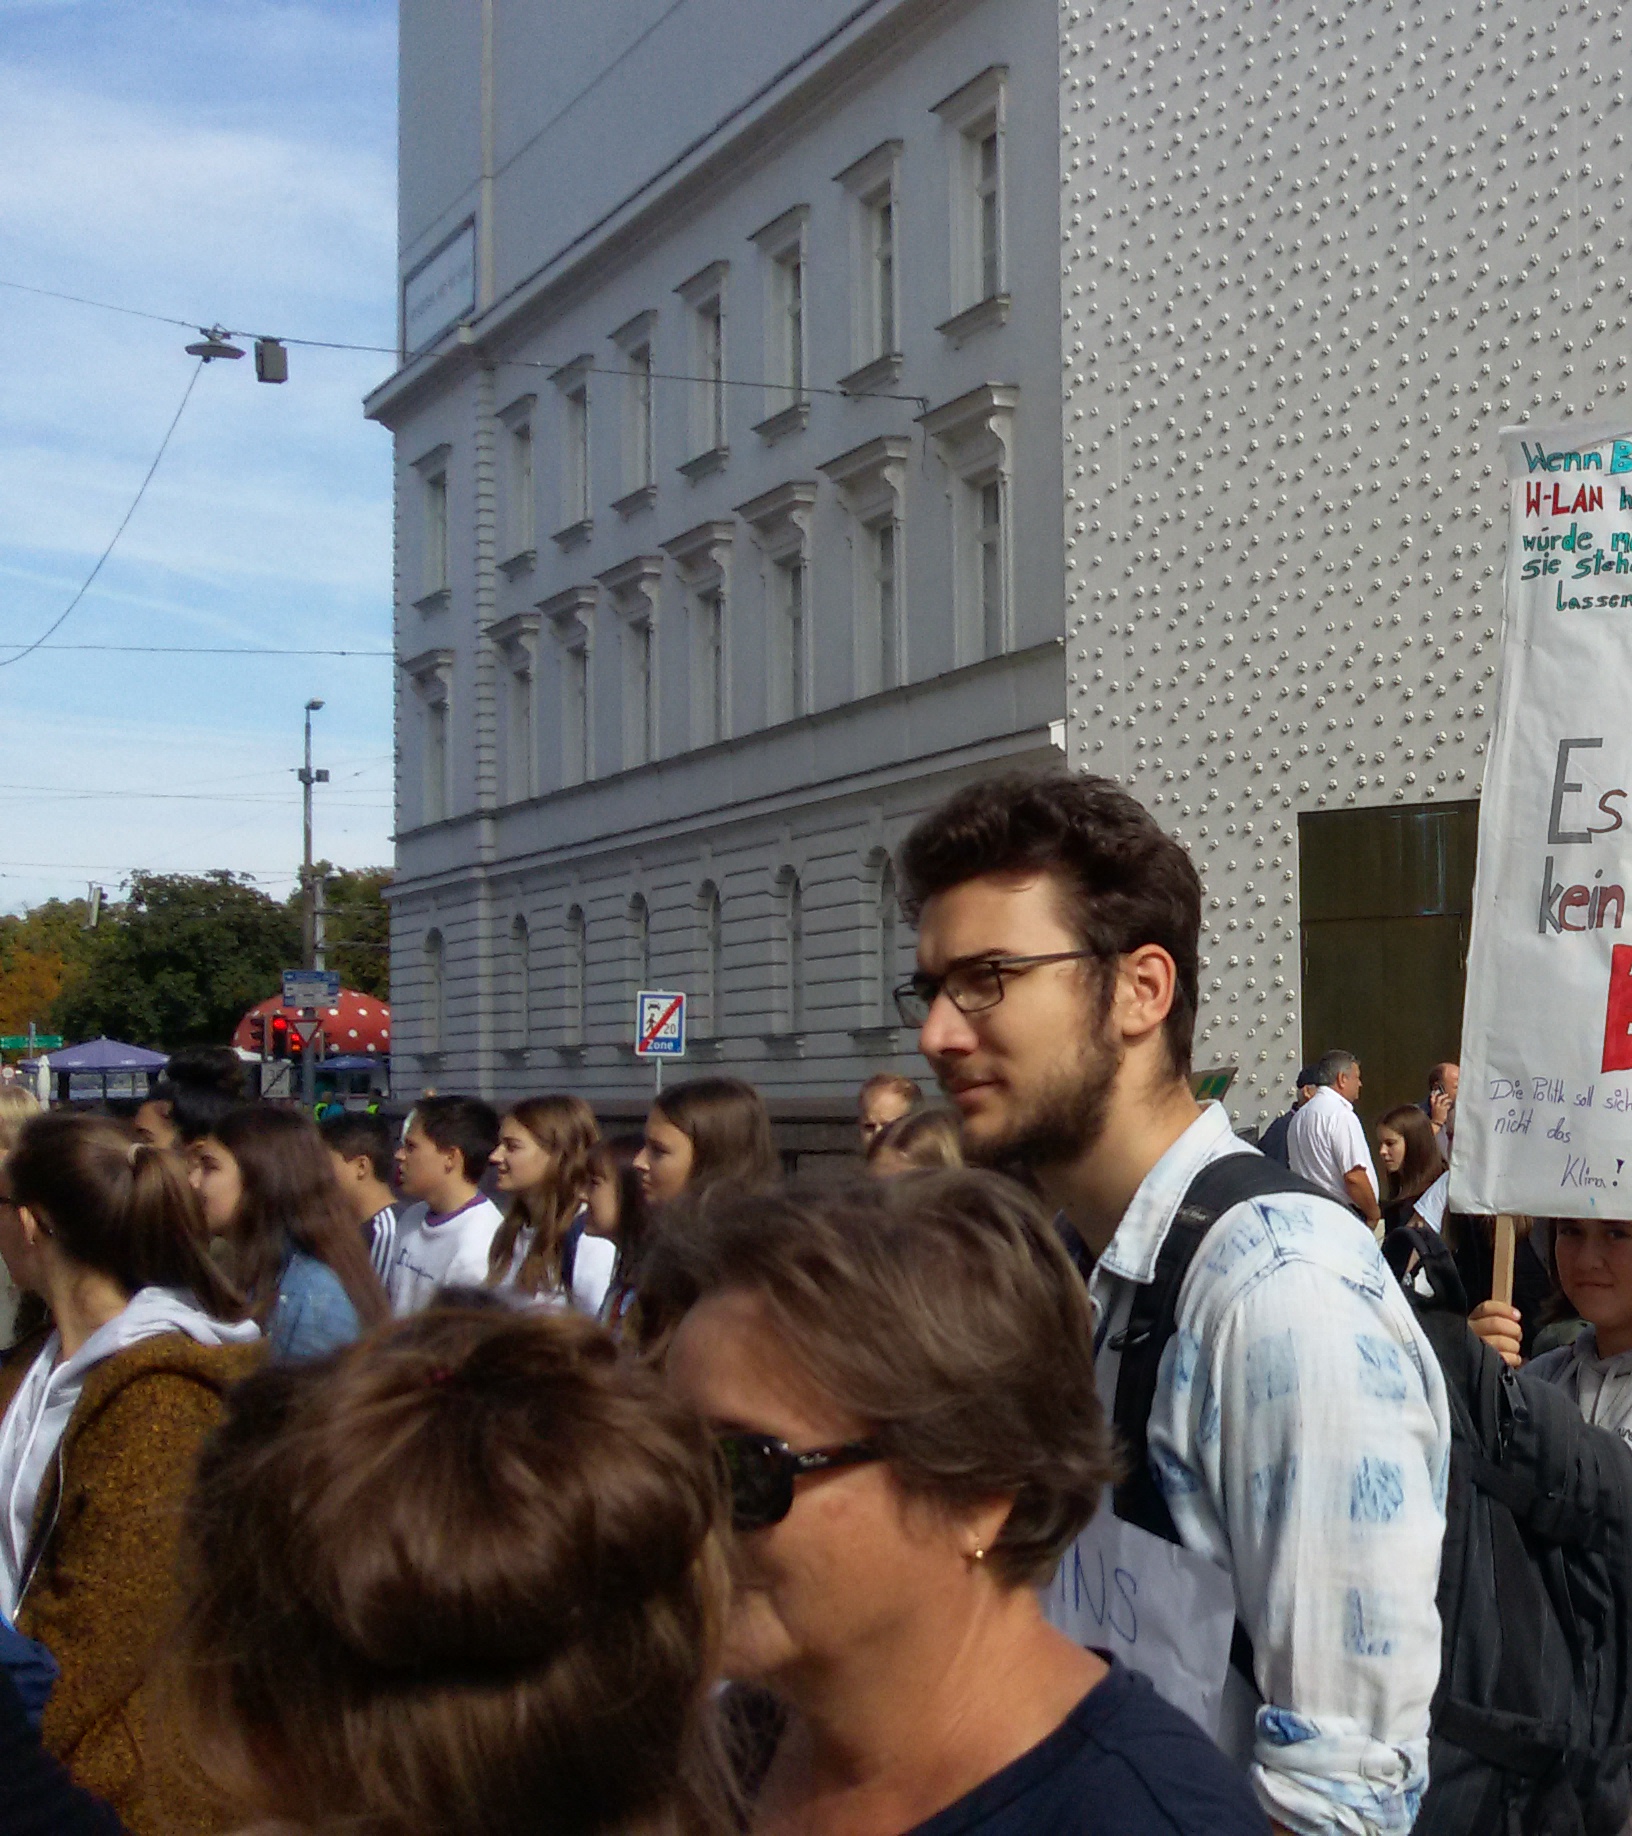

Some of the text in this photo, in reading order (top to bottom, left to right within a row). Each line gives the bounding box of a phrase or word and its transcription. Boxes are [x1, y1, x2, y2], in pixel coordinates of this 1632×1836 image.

[1521, 441, 1603, 474] Wenn
[1525, 481, 1604, 518] W-LAN
[1522, 523, 1593, 554] würde
[1521, 553, 1561, 581] sie
[1547, 737, 1628, 844] Es
[1538, 856, 1625, 934] kein
[663, 1023, 676, 1035] 20
[1489, 1079, 1524, 1101] Die
[1573, 1085, 1594, 1107] soll
[1495, 1108, 1571, 1143] nicht das
